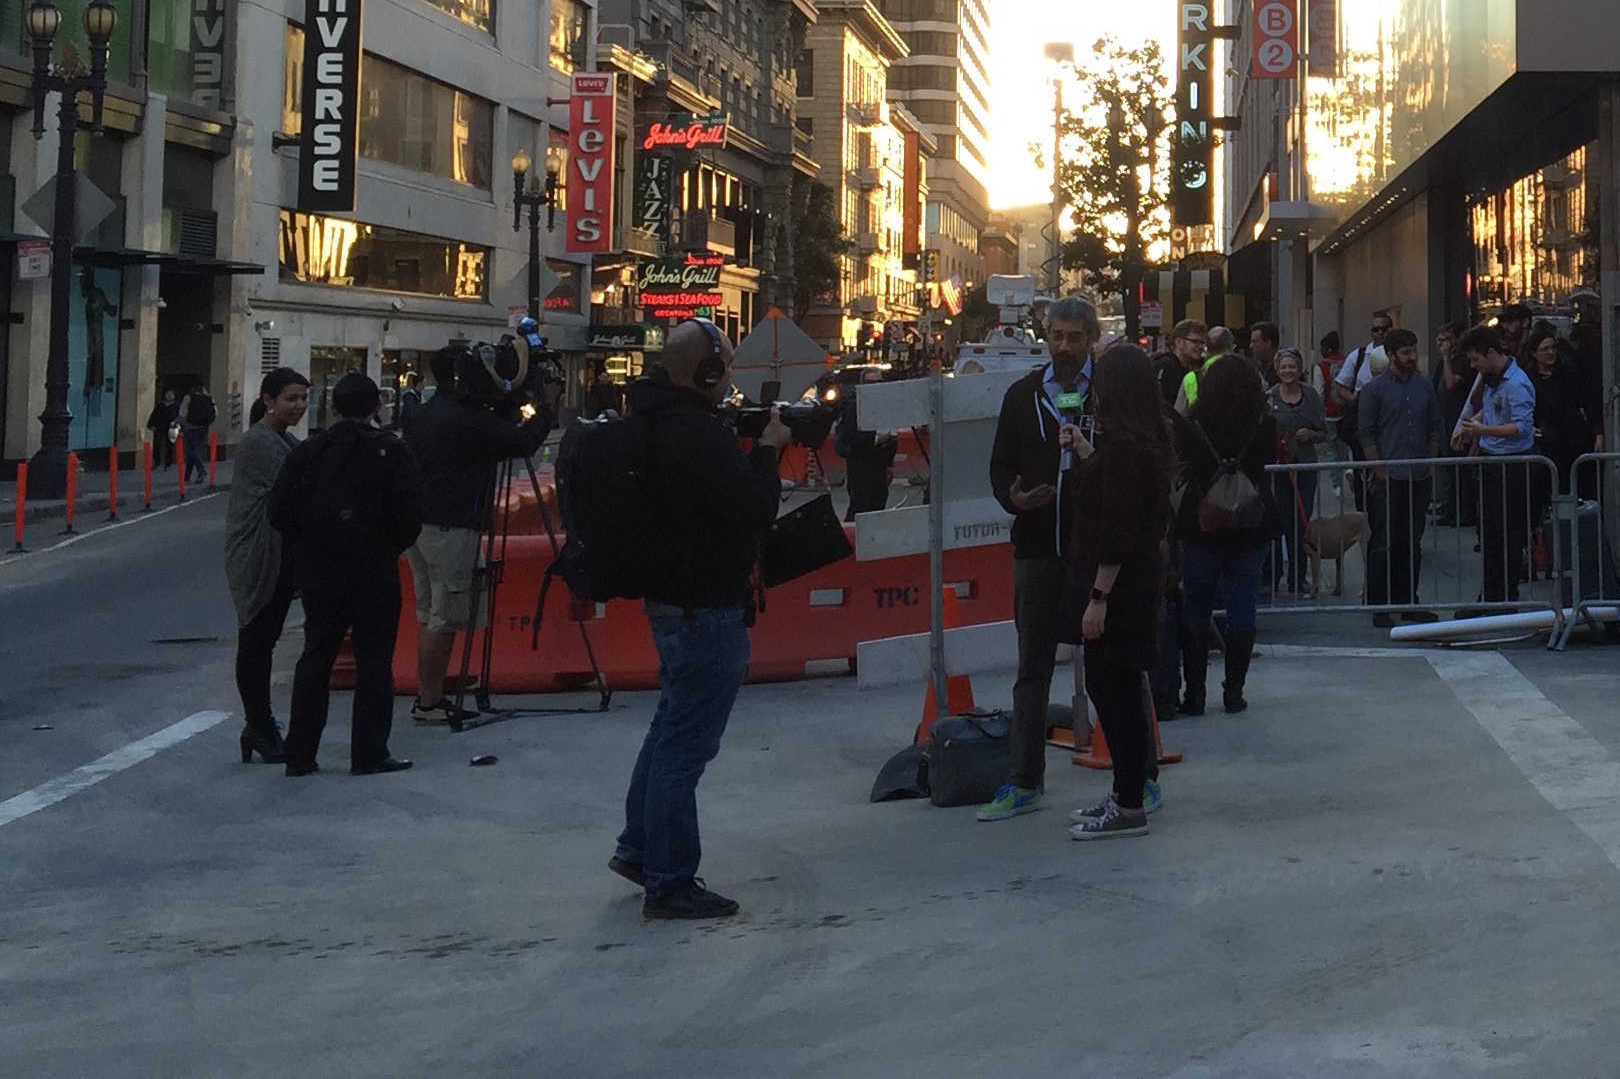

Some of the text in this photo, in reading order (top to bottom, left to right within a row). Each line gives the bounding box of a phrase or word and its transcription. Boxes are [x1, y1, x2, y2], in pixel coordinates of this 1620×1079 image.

[643, 158, 662, 241] JAZZ
[639, 264, 718, 289] John's Grill
[873, 586, 919, 608] TPC
